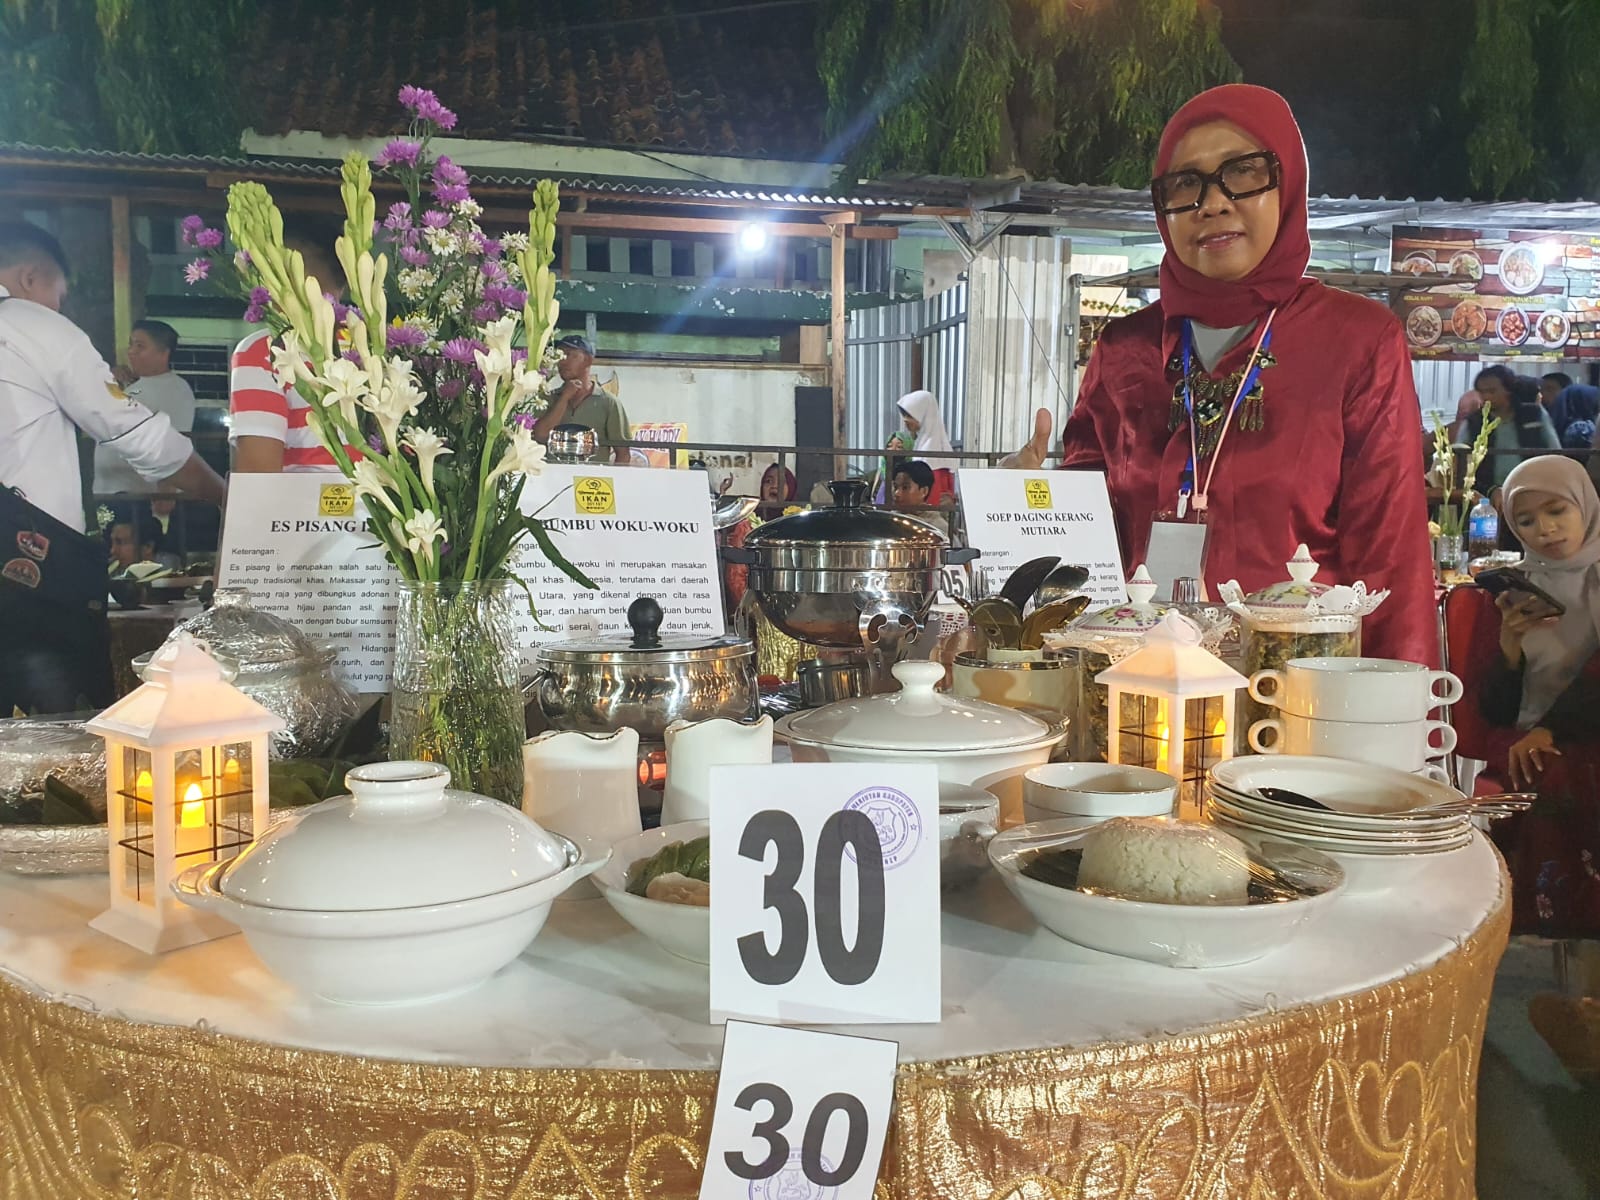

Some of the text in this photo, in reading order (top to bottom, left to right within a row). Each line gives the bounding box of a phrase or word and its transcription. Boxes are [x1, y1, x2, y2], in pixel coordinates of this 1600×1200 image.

[986, 512, 1094, 522] SOEP DAGING KERANG
[271, 520, 290, 532] ES
[295, 520, 356, 532] PISANG
[600, 519, 699, 533] WOKU-WOKU
[1021, 526, 1067, 536] MUTIARA
[246, 564, 270, 572] pisang
[291, 564, 333, 572] merupakan
[339, 563, 359, 571] salah
[605, 560, 615, 568] ini
[620, 561, 666, 571] merupakan
[228, 578, 259, 586] penutup
[263, 577, 302, 585] tradisional
[329, 577, 366, 585] Makassar
[542, 576, 564, 584] khas
[619, 576, 656, 584] terutama
[661, 576, 676, 584] dari
[681, 576, 709, 584] daerah
[317, 591, 356, 599] dibungkus
[539, 592, 566, 601] Utara,
[573, 592, 594, 601] yang
[600, 591, 630, 599] dikenal
[673, 591, 687, 599] cita
[296, 604, 315, 612] hijau
[323, 604, 352, 612] pandan
[578, 607, 606, 616] harum
[684, 607, 711, 615] bumbu
[305, 618, 334, 627] dengan
[569, 624, 593, 633] serai,
[598, 622, 619, 630] daun
[667, 621, 687, 630] daun
[737, 809, 886, 986] 30
[723, 1082, 869, 1187] 30
